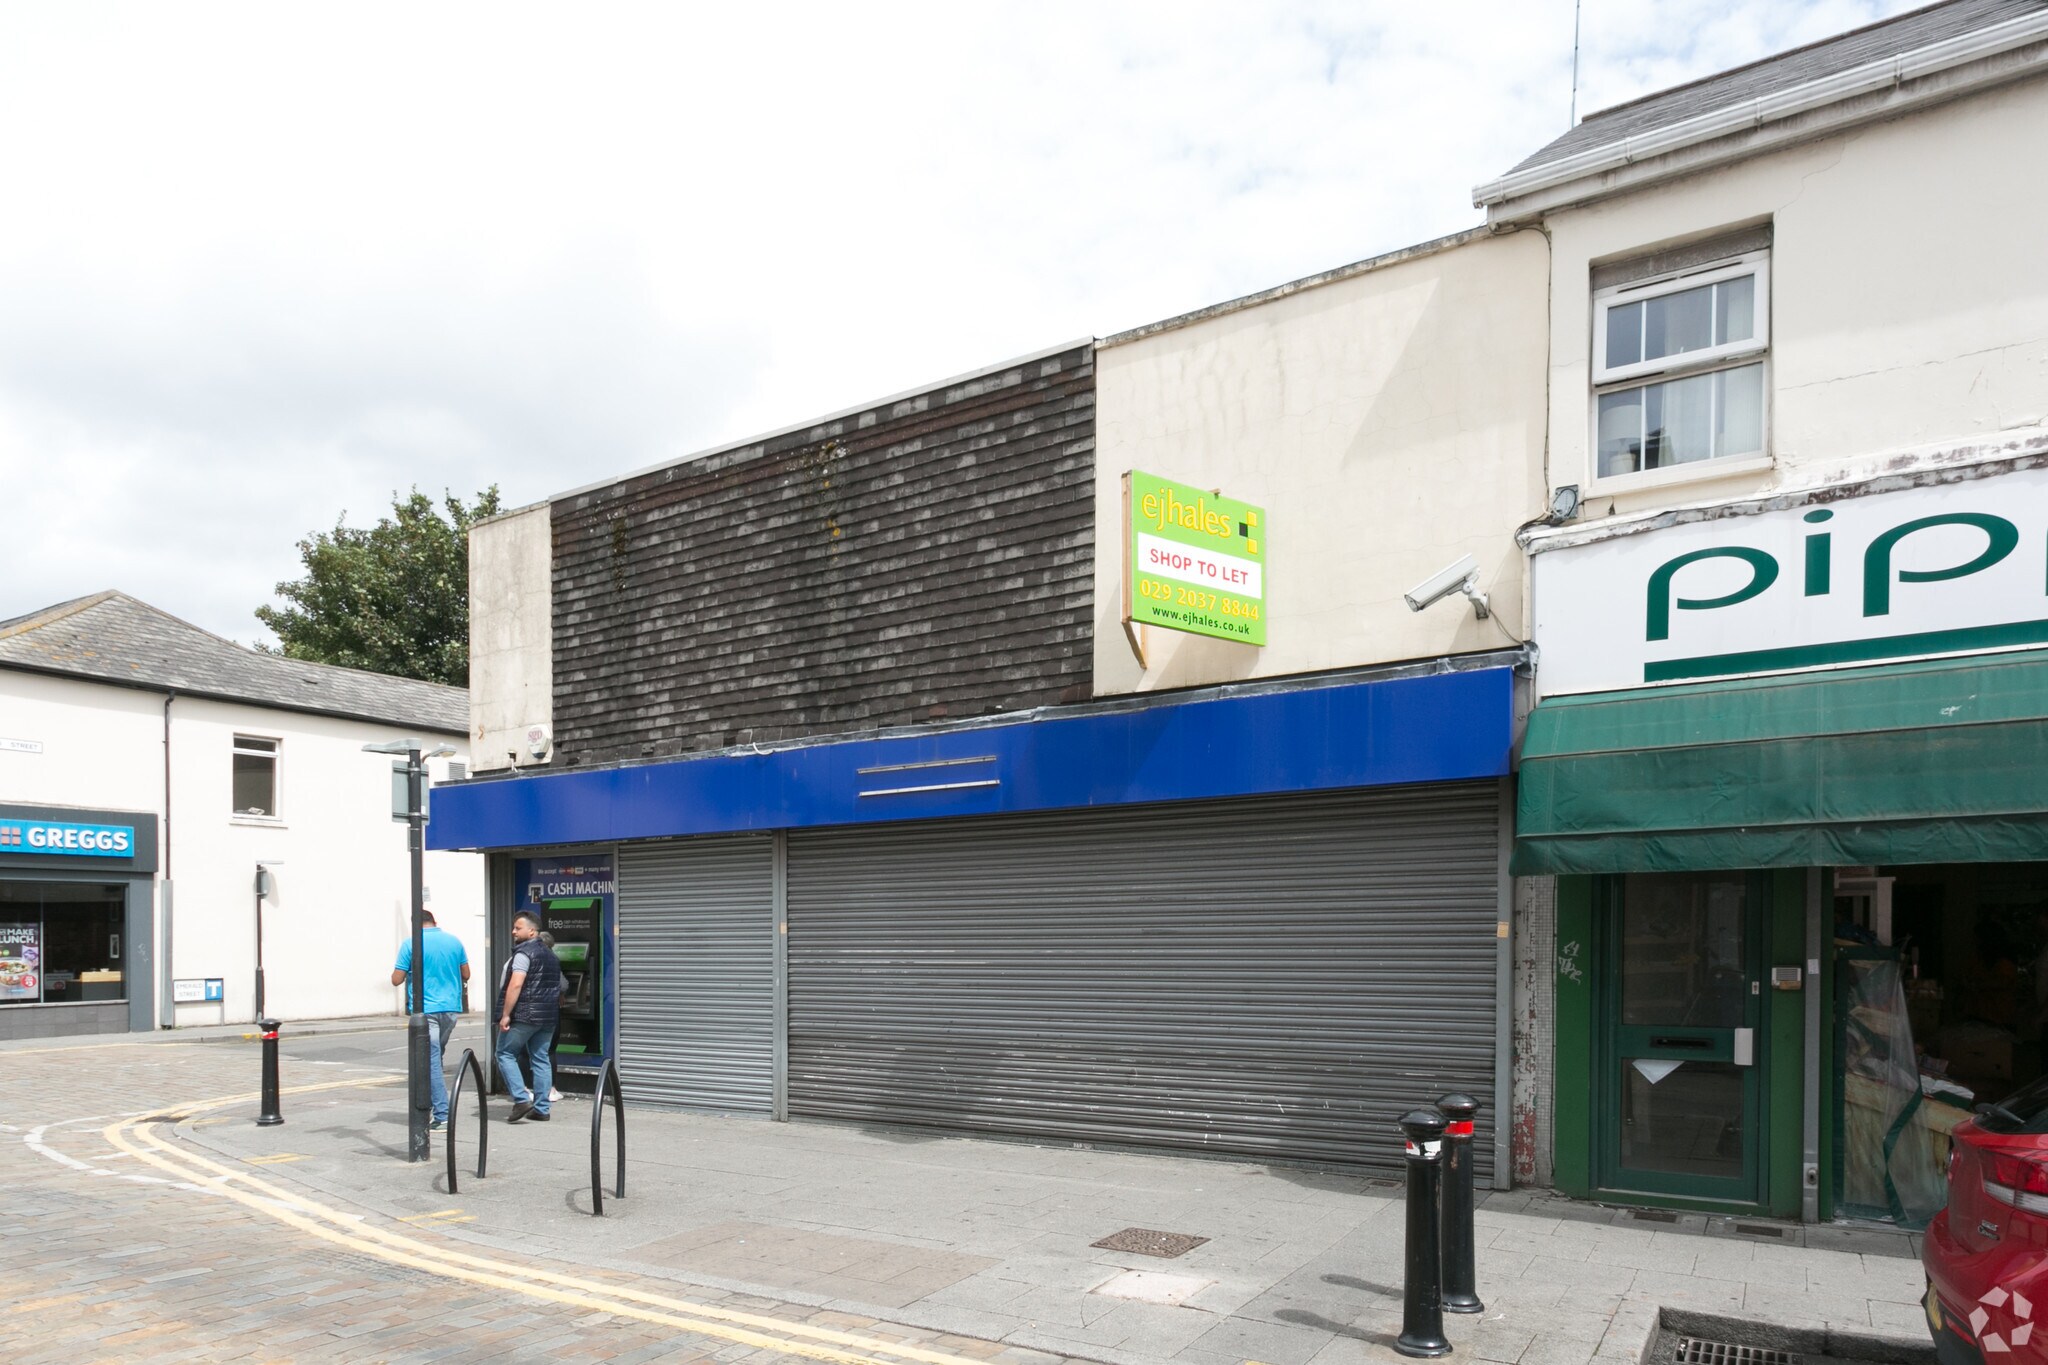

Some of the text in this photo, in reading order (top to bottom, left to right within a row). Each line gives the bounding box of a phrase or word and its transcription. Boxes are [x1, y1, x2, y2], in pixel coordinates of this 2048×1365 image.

[1141, 488, 1232, 538] ejhales
[1150, 548, 1249, 585] SHOP TO LET
[1646, 508, 2048, 642] pip
[1140, 579, 1260, 621] 029 2037 8844
[1152, 606, 1250, 635] www.ejhales.co.uk
[10, 741, 38, 750] STREET
[27, 827, 129, 851] GREGGS
[547, 882, 573, 896] CASH
[7, 928, 34, 936] MAKE
[548, 917, 564, 929] free
